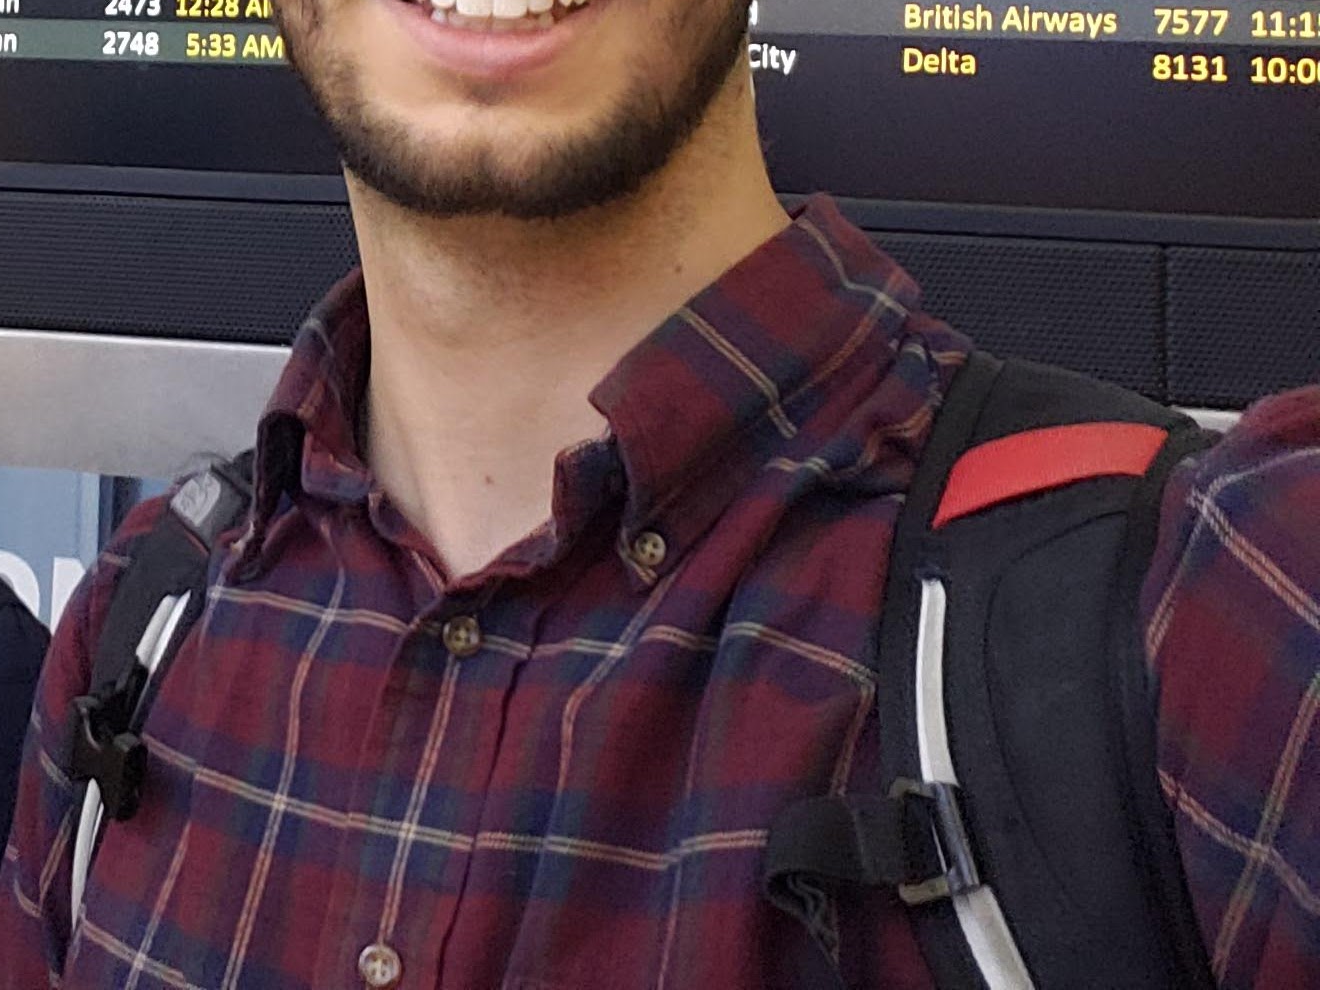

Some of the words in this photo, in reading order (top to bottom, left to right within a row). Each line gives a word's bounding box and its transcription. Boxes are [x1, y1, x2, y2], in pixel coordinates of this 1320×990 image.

[904, 4, 993, 31] British
[1001, 5, 1118, 40] Airways
[1153, 9, 1229, 36] 7577
[103, 31, 159, 57] 2748
[186, 33, 236, 58] 5:33
[242, 35, 284, 59] AM
[746, 44, 797, 76] City
[902, 47, 977, 75] Delta
[1152, 54, 1228, 82] 8131
